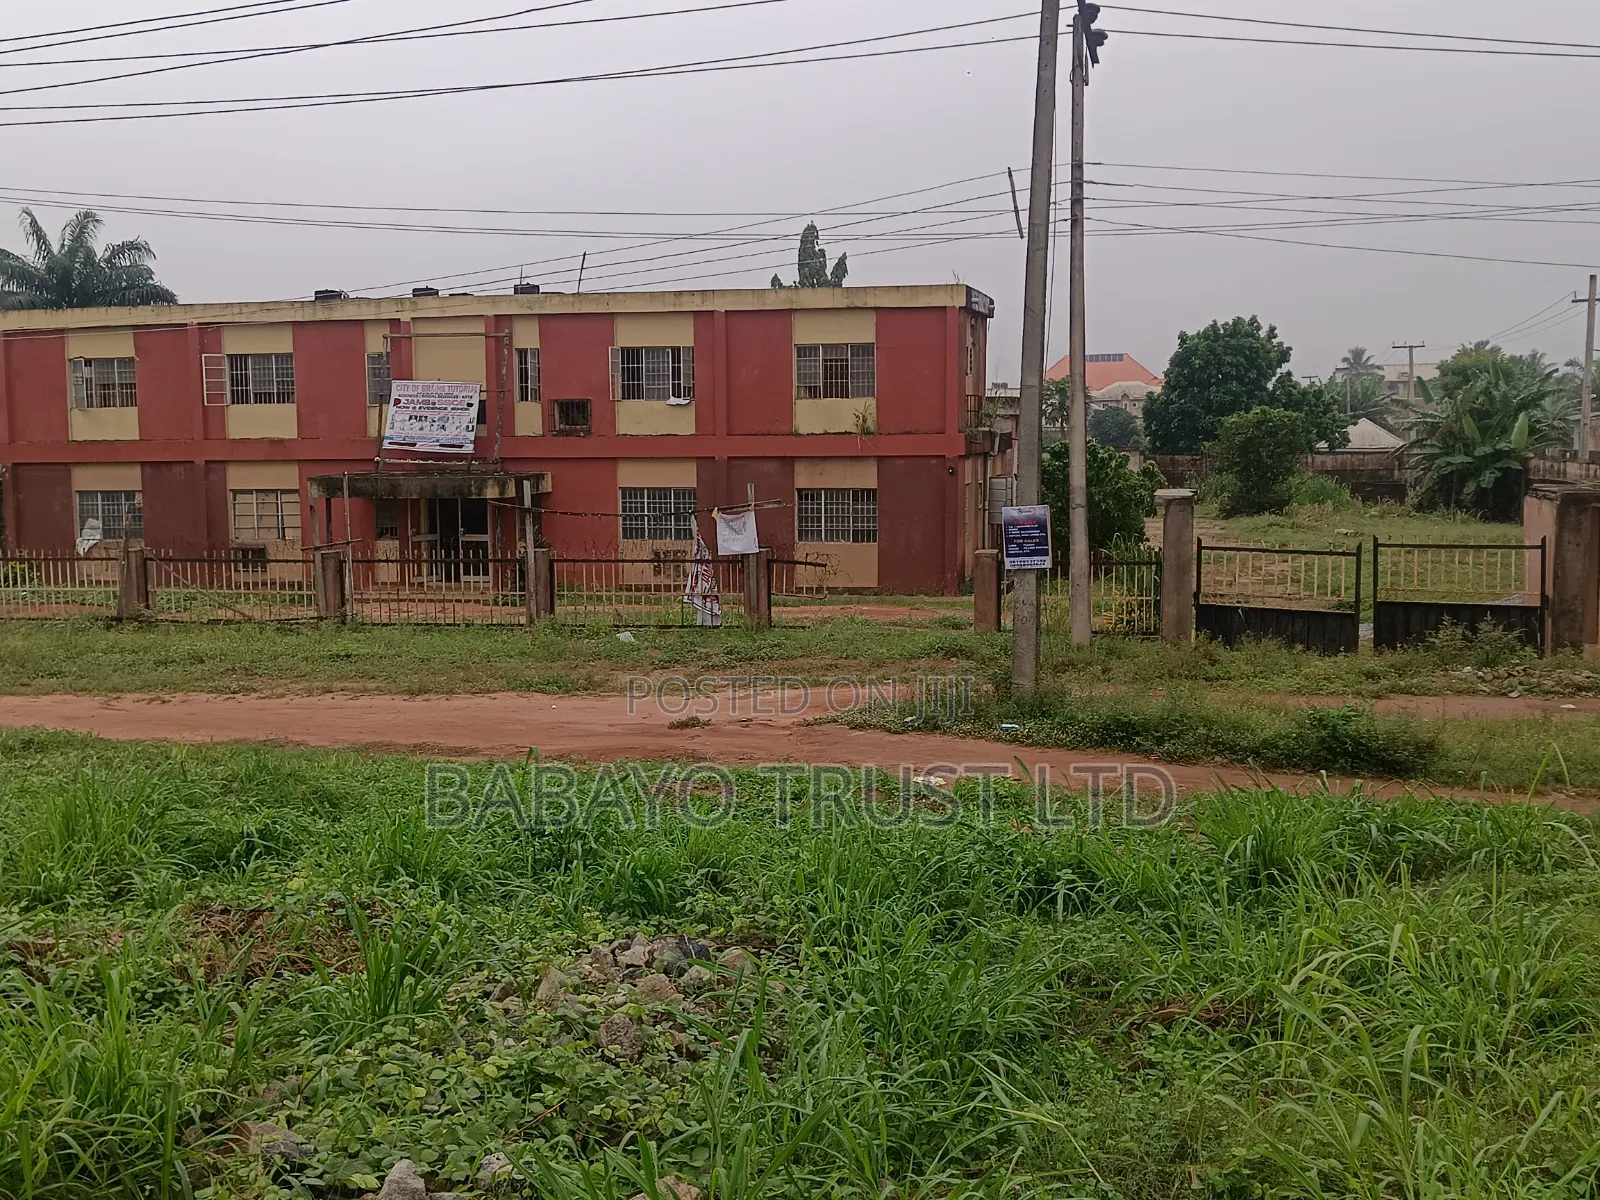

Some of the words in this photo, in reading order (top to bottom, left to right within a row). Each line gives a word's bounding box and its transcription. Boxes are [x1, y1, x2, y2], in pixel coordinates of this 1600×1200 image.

[396, 384, 410, 392] CITY
[412, 384, 420, 392] OF
[422, 385, 446, 393] BRAINS
